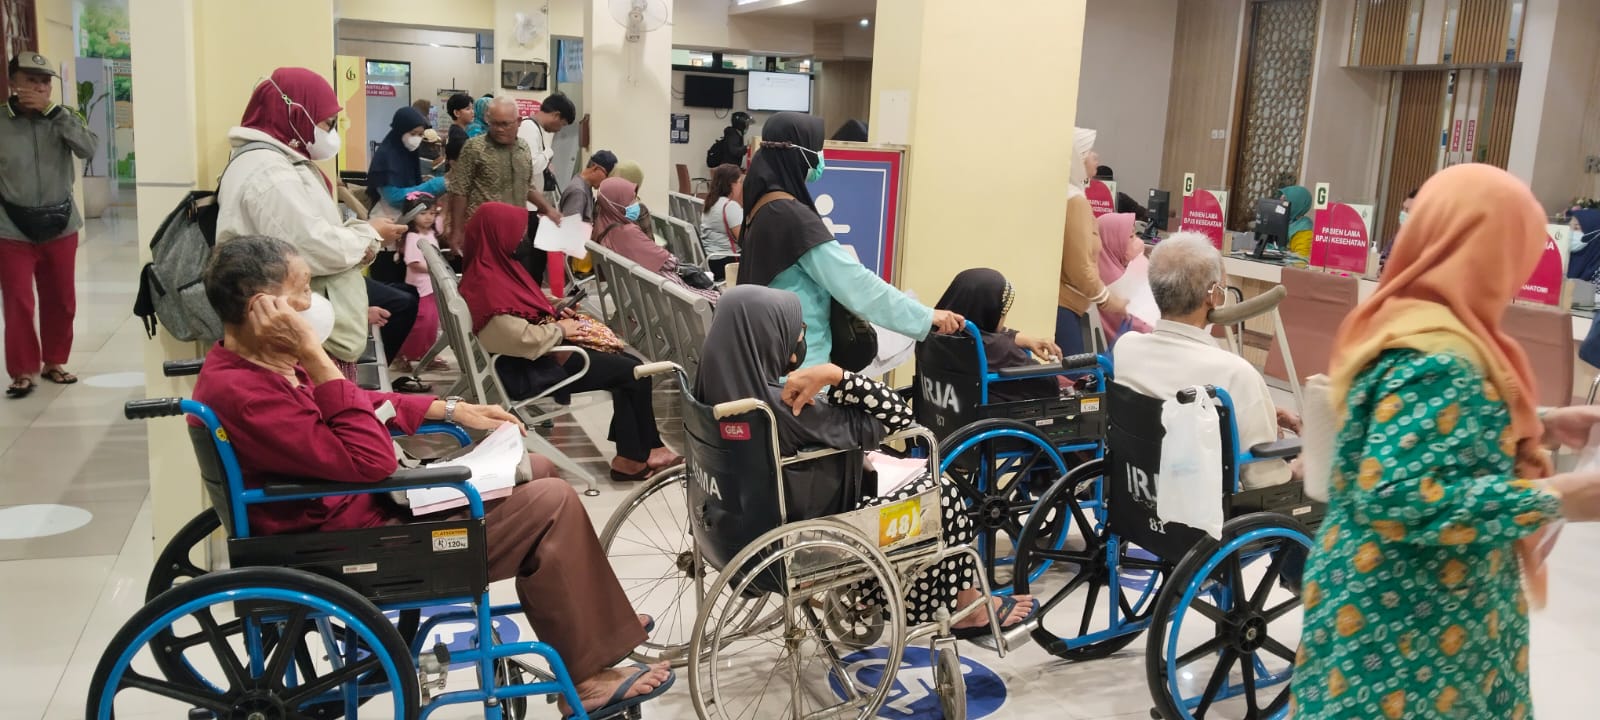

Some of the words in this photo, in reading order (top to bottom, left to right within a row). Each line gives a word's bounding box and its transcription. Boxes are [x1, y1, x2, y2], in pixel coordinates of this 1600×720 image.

[1185, 177, 1193, 193] G
[1317, 187, 1326, 205] G
[1189, 210, 1205, 218] PASIEN
[1195, 218, 1223, 228] KESEHATAN
[1322, 227, 1344, 236] PASIEN
[1344, 229, 1361, 238] LAMA
[1331, 237, 1366, 247] KESEHATAN
[920, 370, 960, 414] IRJA
[725, 425, 744, 434] GEA
[1126, 462, 1160, 503] IRJ
[1149, 517, 1167, 535] 81
